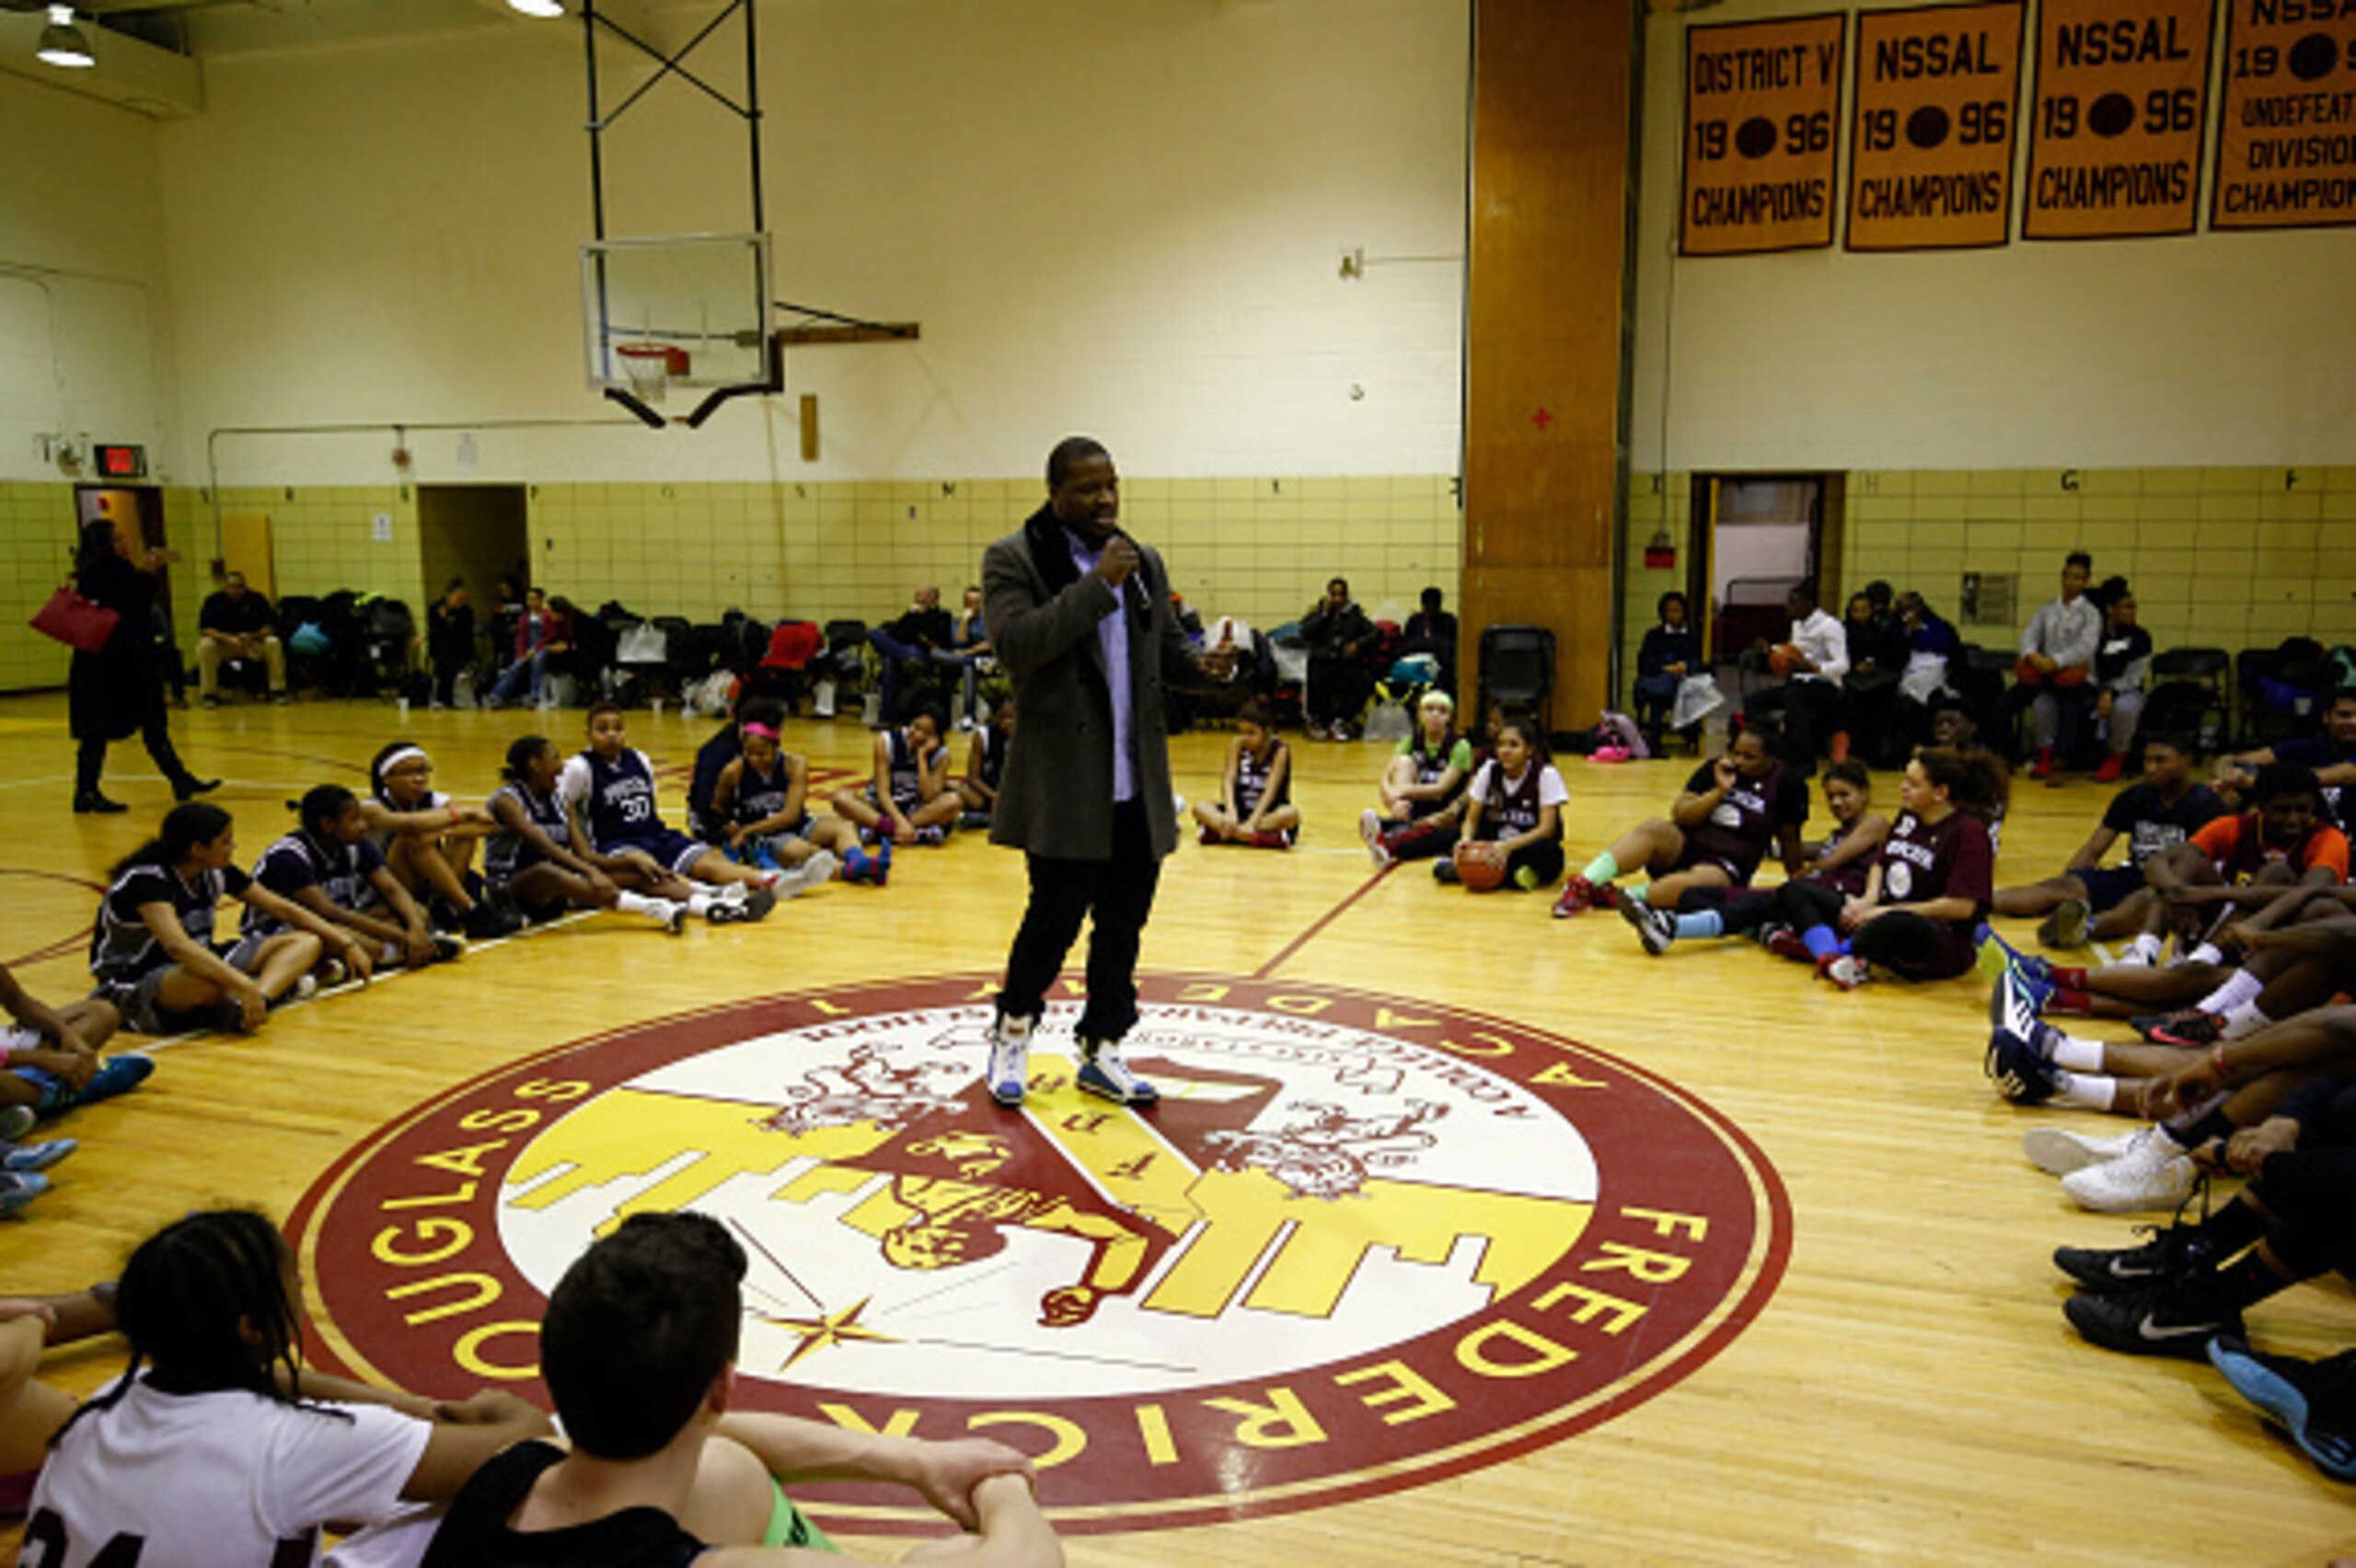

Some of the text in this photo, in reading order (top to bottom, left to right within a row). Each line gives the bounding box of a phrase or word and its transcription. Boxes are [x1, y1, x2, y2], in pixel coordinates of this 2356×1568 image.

[1876, 32, 2001, 81] NSSAL
[2058, 16, 2189, 69] NSSAL
[2235, 46, 2279, 78] 19
[1694, 42, 1834, 94] DISTRICT V
[1694, 111, 1830, 160] 19 96
[1862, 101, 2007, 151] 19 96
[2044, 88, 2197, 139] 19 96
[2249, 134, 2356, 170] DIVISIO
[1692, 179, 1826, 226] CHAMPIONS
[1860, 171, 2001, 219] CHAMPIONS
[2037, 158, 2189, 209] CHAMPIONS
[2062, 468, 2079, 491] G
[2285, 468, 2300, 491] F
[370, 1077, 594, 1379] OUGLASS
